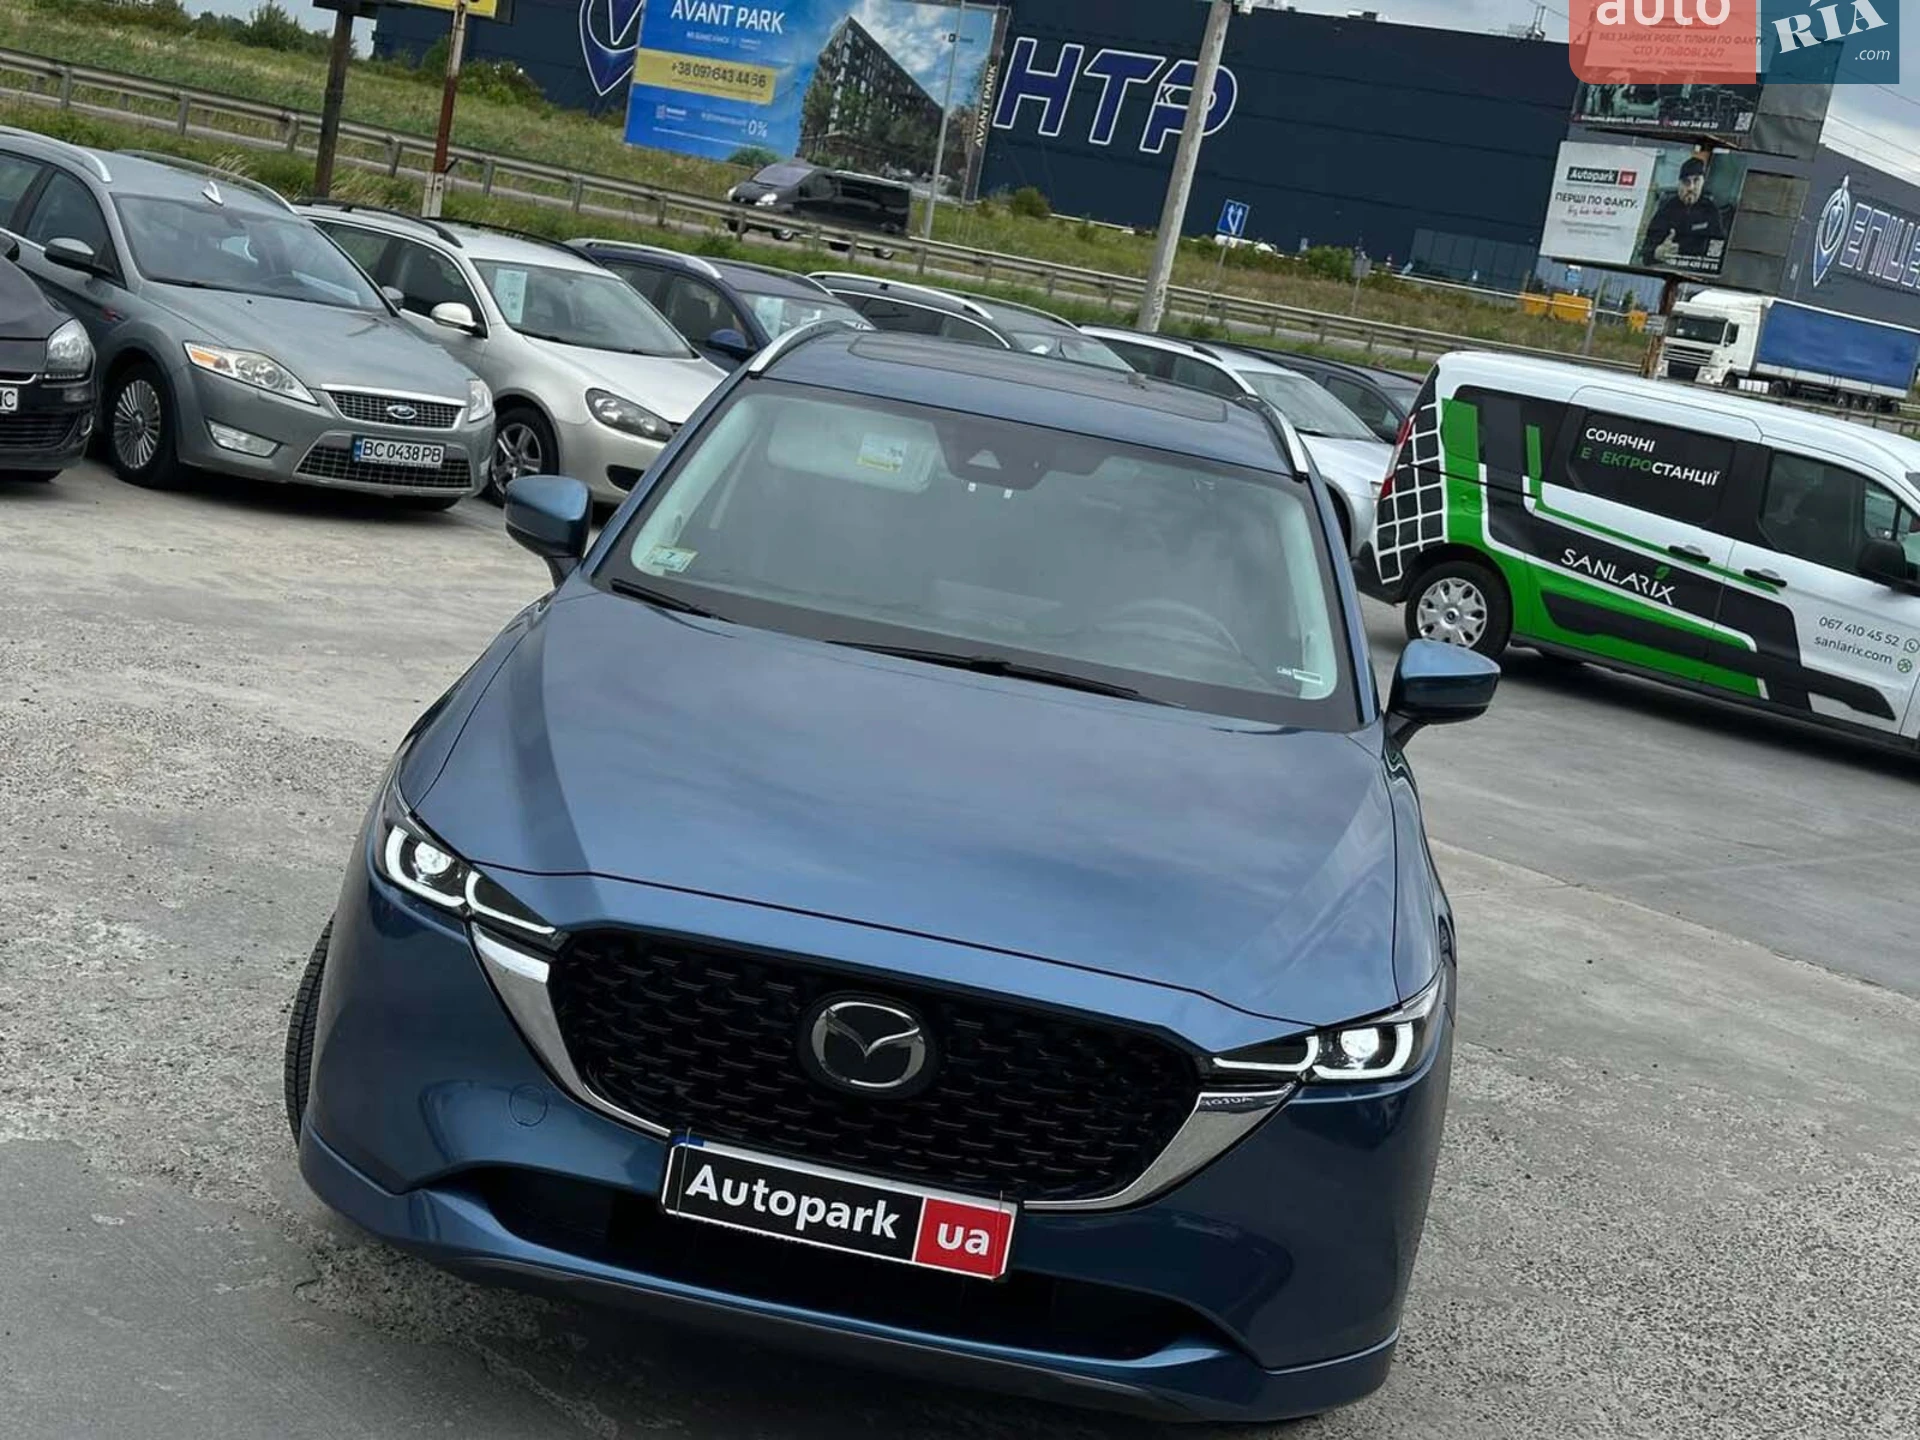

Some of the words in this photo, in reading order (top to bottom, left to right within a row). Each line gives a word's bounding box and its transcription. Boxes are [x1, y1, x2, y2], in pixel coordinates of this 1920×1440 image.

[671, 0, 733, 26] AVANT
[735, 8, 785, 34] PARK
[671, 60, 691, 76] +38
[711, 68, 734, 84] 643
[736, 72, 751, 85] 44
[975, 103, 990, 148] AVANT
[983, 63, 998, 100] PARK
[748, 119, 768, 138] 0%
[1569, 168, 1616, 183] Autopark
[1555, 191, 1586, 204] ПЕРШІ
[1587, 195, 1602, 205] ПО
[1603, 197, 1638, 209] ФАКТУ.
[363, 441, 385, 458] BC
[386, 444, 420, 461] 0438
[421, 446, 441, 463] PB
[1585, 427, 1656, 453] СОНЯЧНІ
[1560, 548, 1676, 606] SANLARIX
[1819, 616, 1843, 630] 067
[1844, 623, 1865, 637] 410
[1867, 629, 1883, 642] 45
[1884, 633, 1900, 647] 52
[1813, 635, 1893, 665] sanlarix.com
[686, 1164, 900, 1239] Autopark
[935, 1221, 990, 1256] ua
